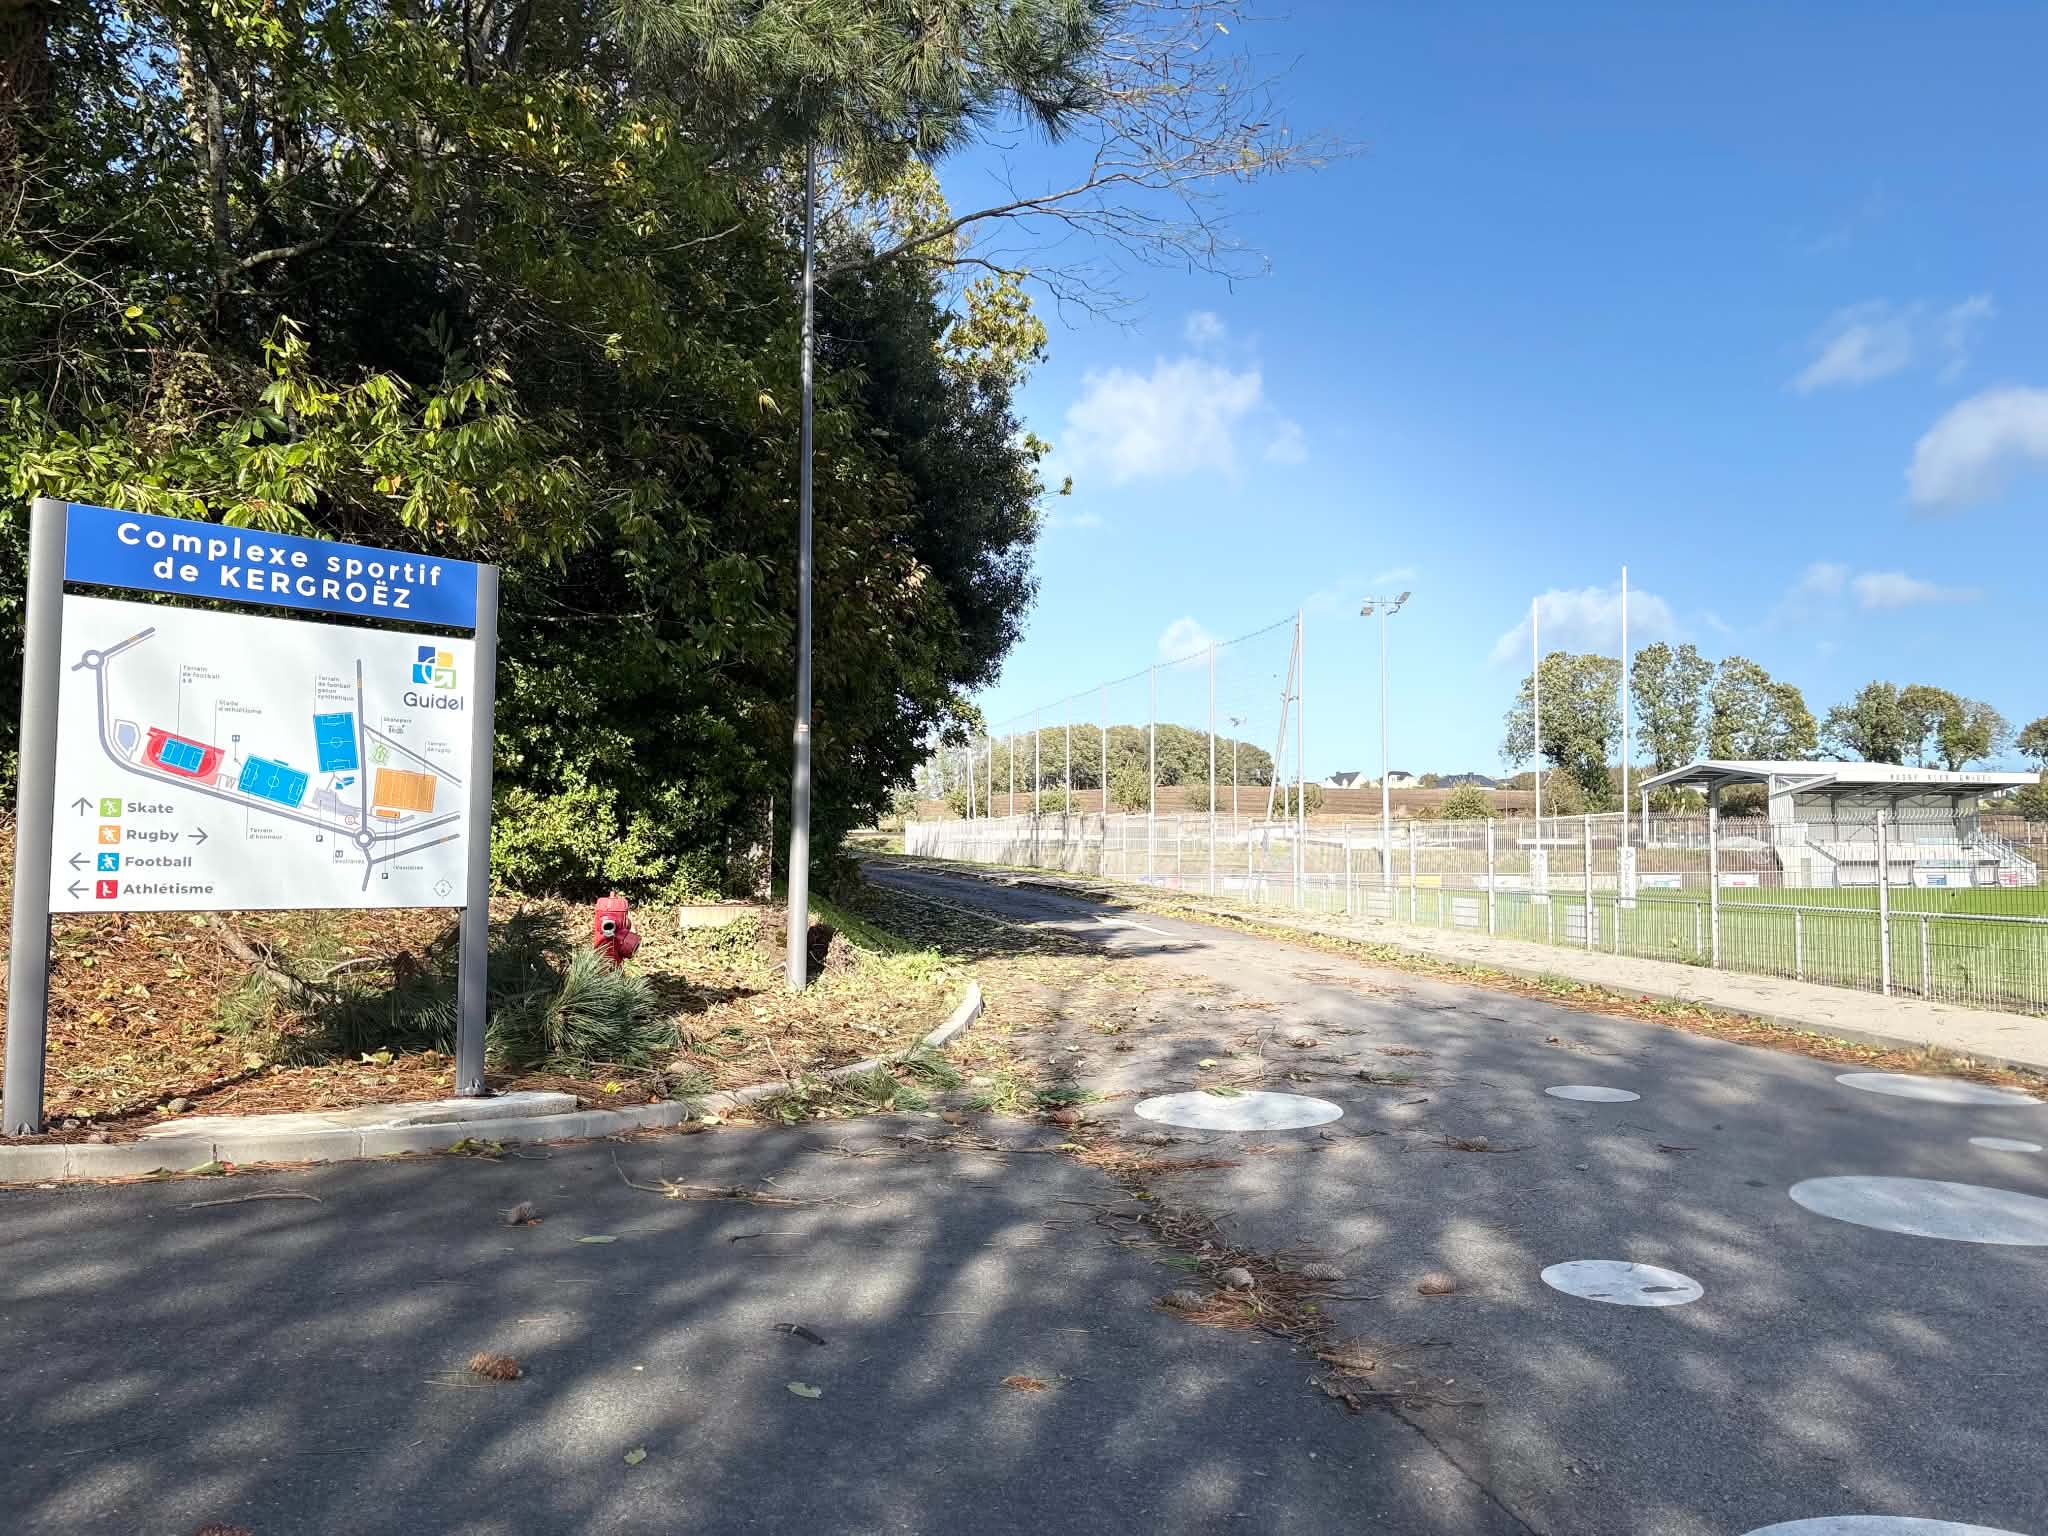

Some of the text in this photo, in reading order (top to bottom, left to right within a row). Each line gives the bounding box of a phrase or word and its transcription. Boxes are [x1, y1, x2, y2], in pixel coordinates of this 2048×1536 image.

[117, 521, 442, 586] Complexe sportif
[153, 556, 411, 609] de KERGROËZ
[403, 691, 464, 711] Guidel
[127, 802, 174, 814] Skate
[126, 829, 179, 843] Rugby
[125, 855, 192, 867] Football
[123, 882, 214, 895] Athlétisme
